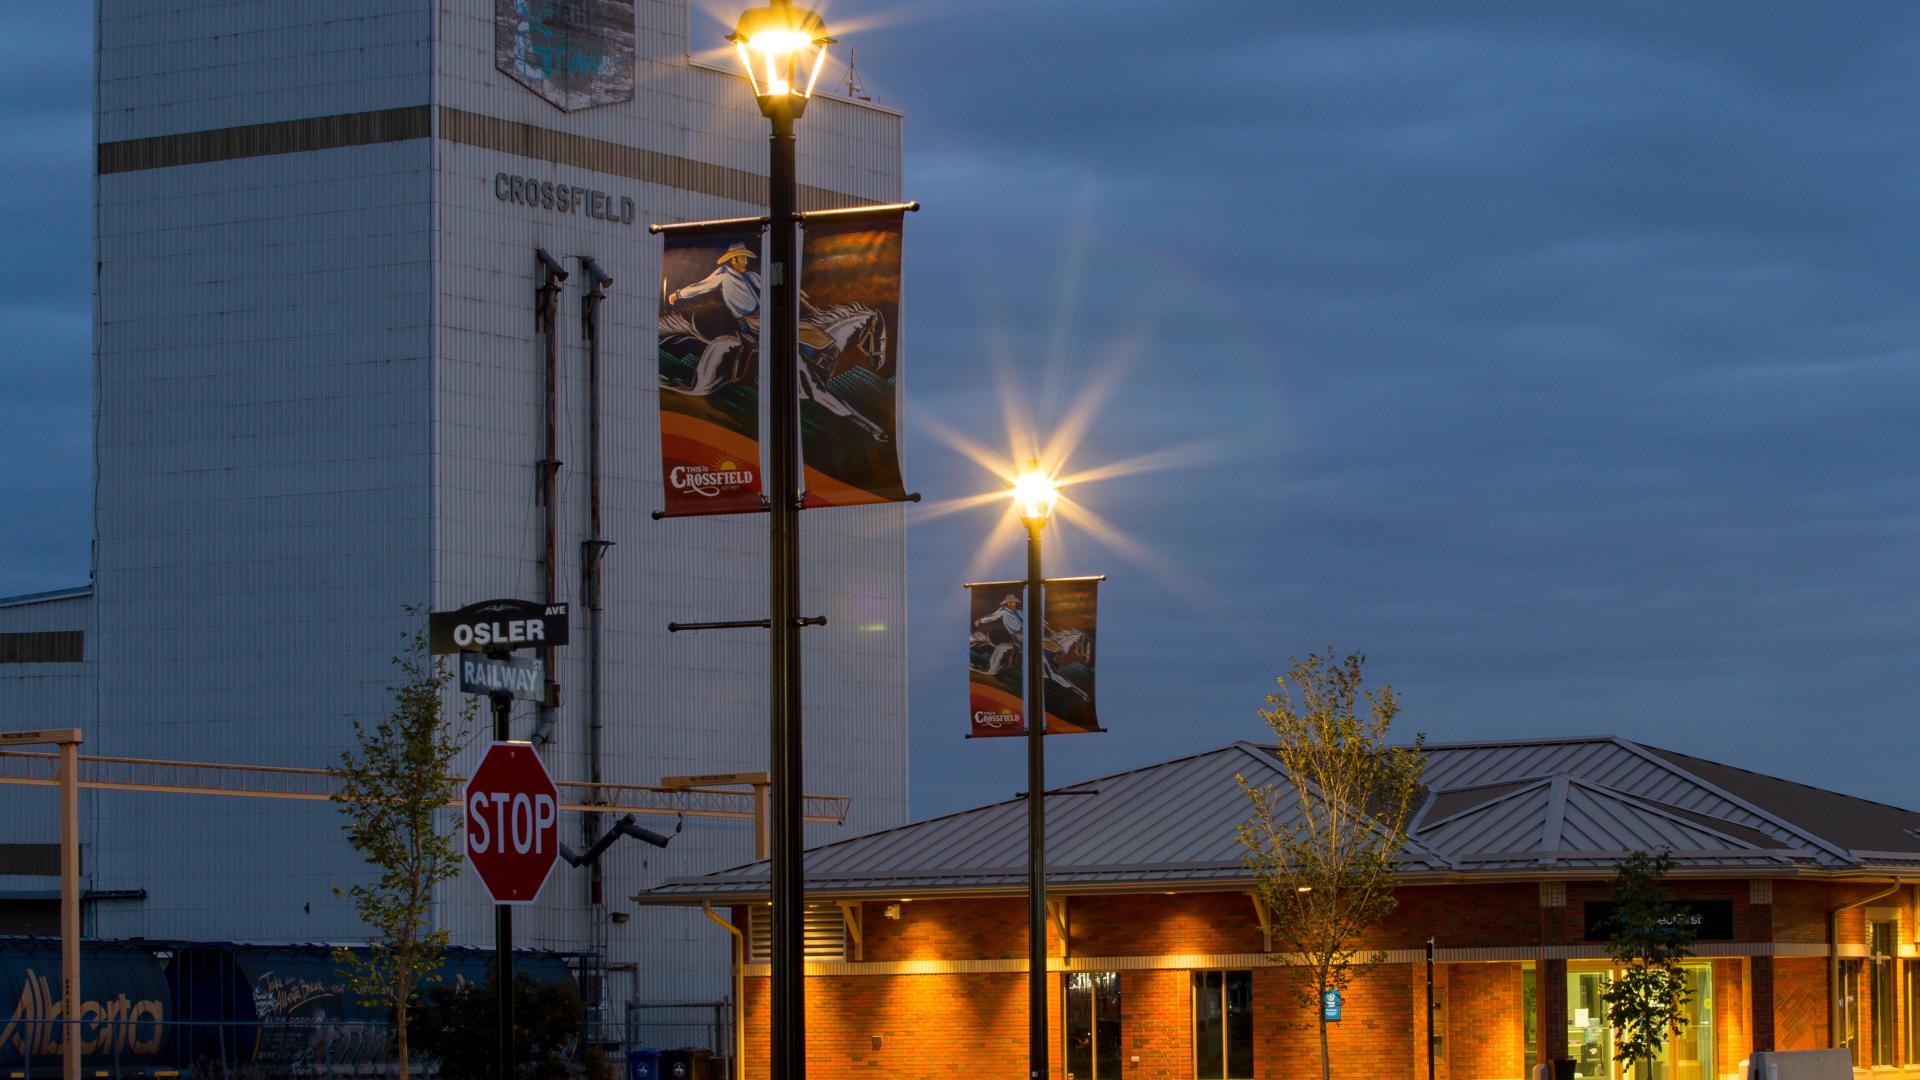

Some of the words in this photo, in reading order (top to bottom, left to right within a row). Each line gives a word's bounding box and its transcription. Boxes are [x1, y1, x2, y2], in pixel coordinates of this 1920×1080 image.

[495, 172, 635, 224] CROSSFIELD
[453, 618, 545, 646] OSLER
[545, 605, 567, 617] AVE
[463, 661, 538, 695] RAILWAY
[468, 791, 555, 855] STOP
[0, 968, 163, 1056] Alberta
